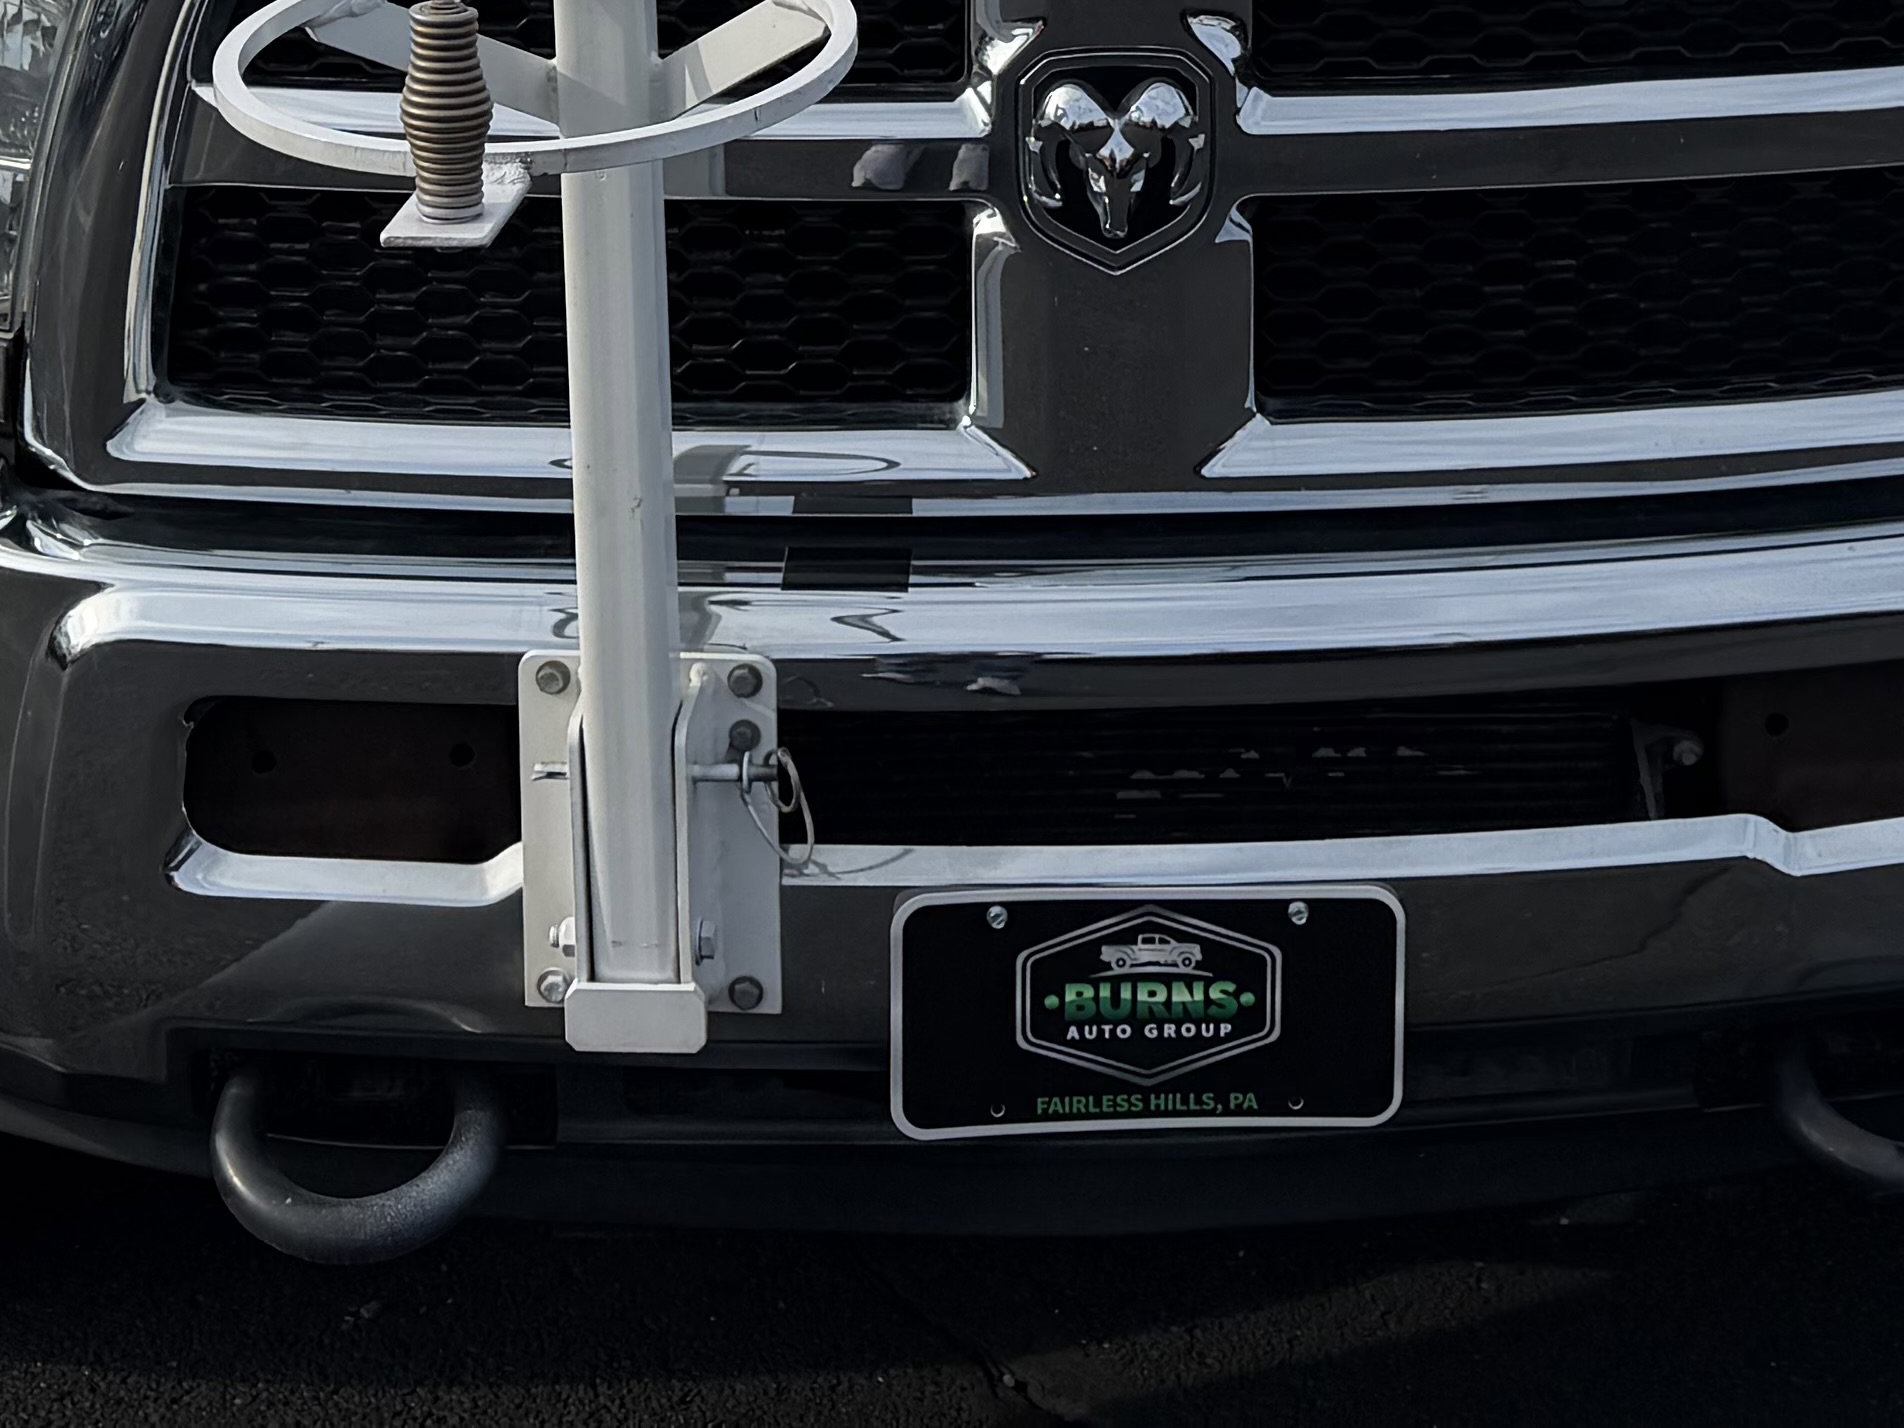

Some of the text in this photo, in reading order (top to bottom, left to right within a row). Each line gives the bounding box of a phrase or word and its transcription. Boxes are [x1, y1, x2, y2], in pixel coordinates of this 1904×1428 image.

[1064, 981, 1239, 1021] BURNS
[1066, 1023, 1232, 1040] AUTO GROUP
[1036, 1092, 1259, 1115] FAIRLESS HILLS, PA
